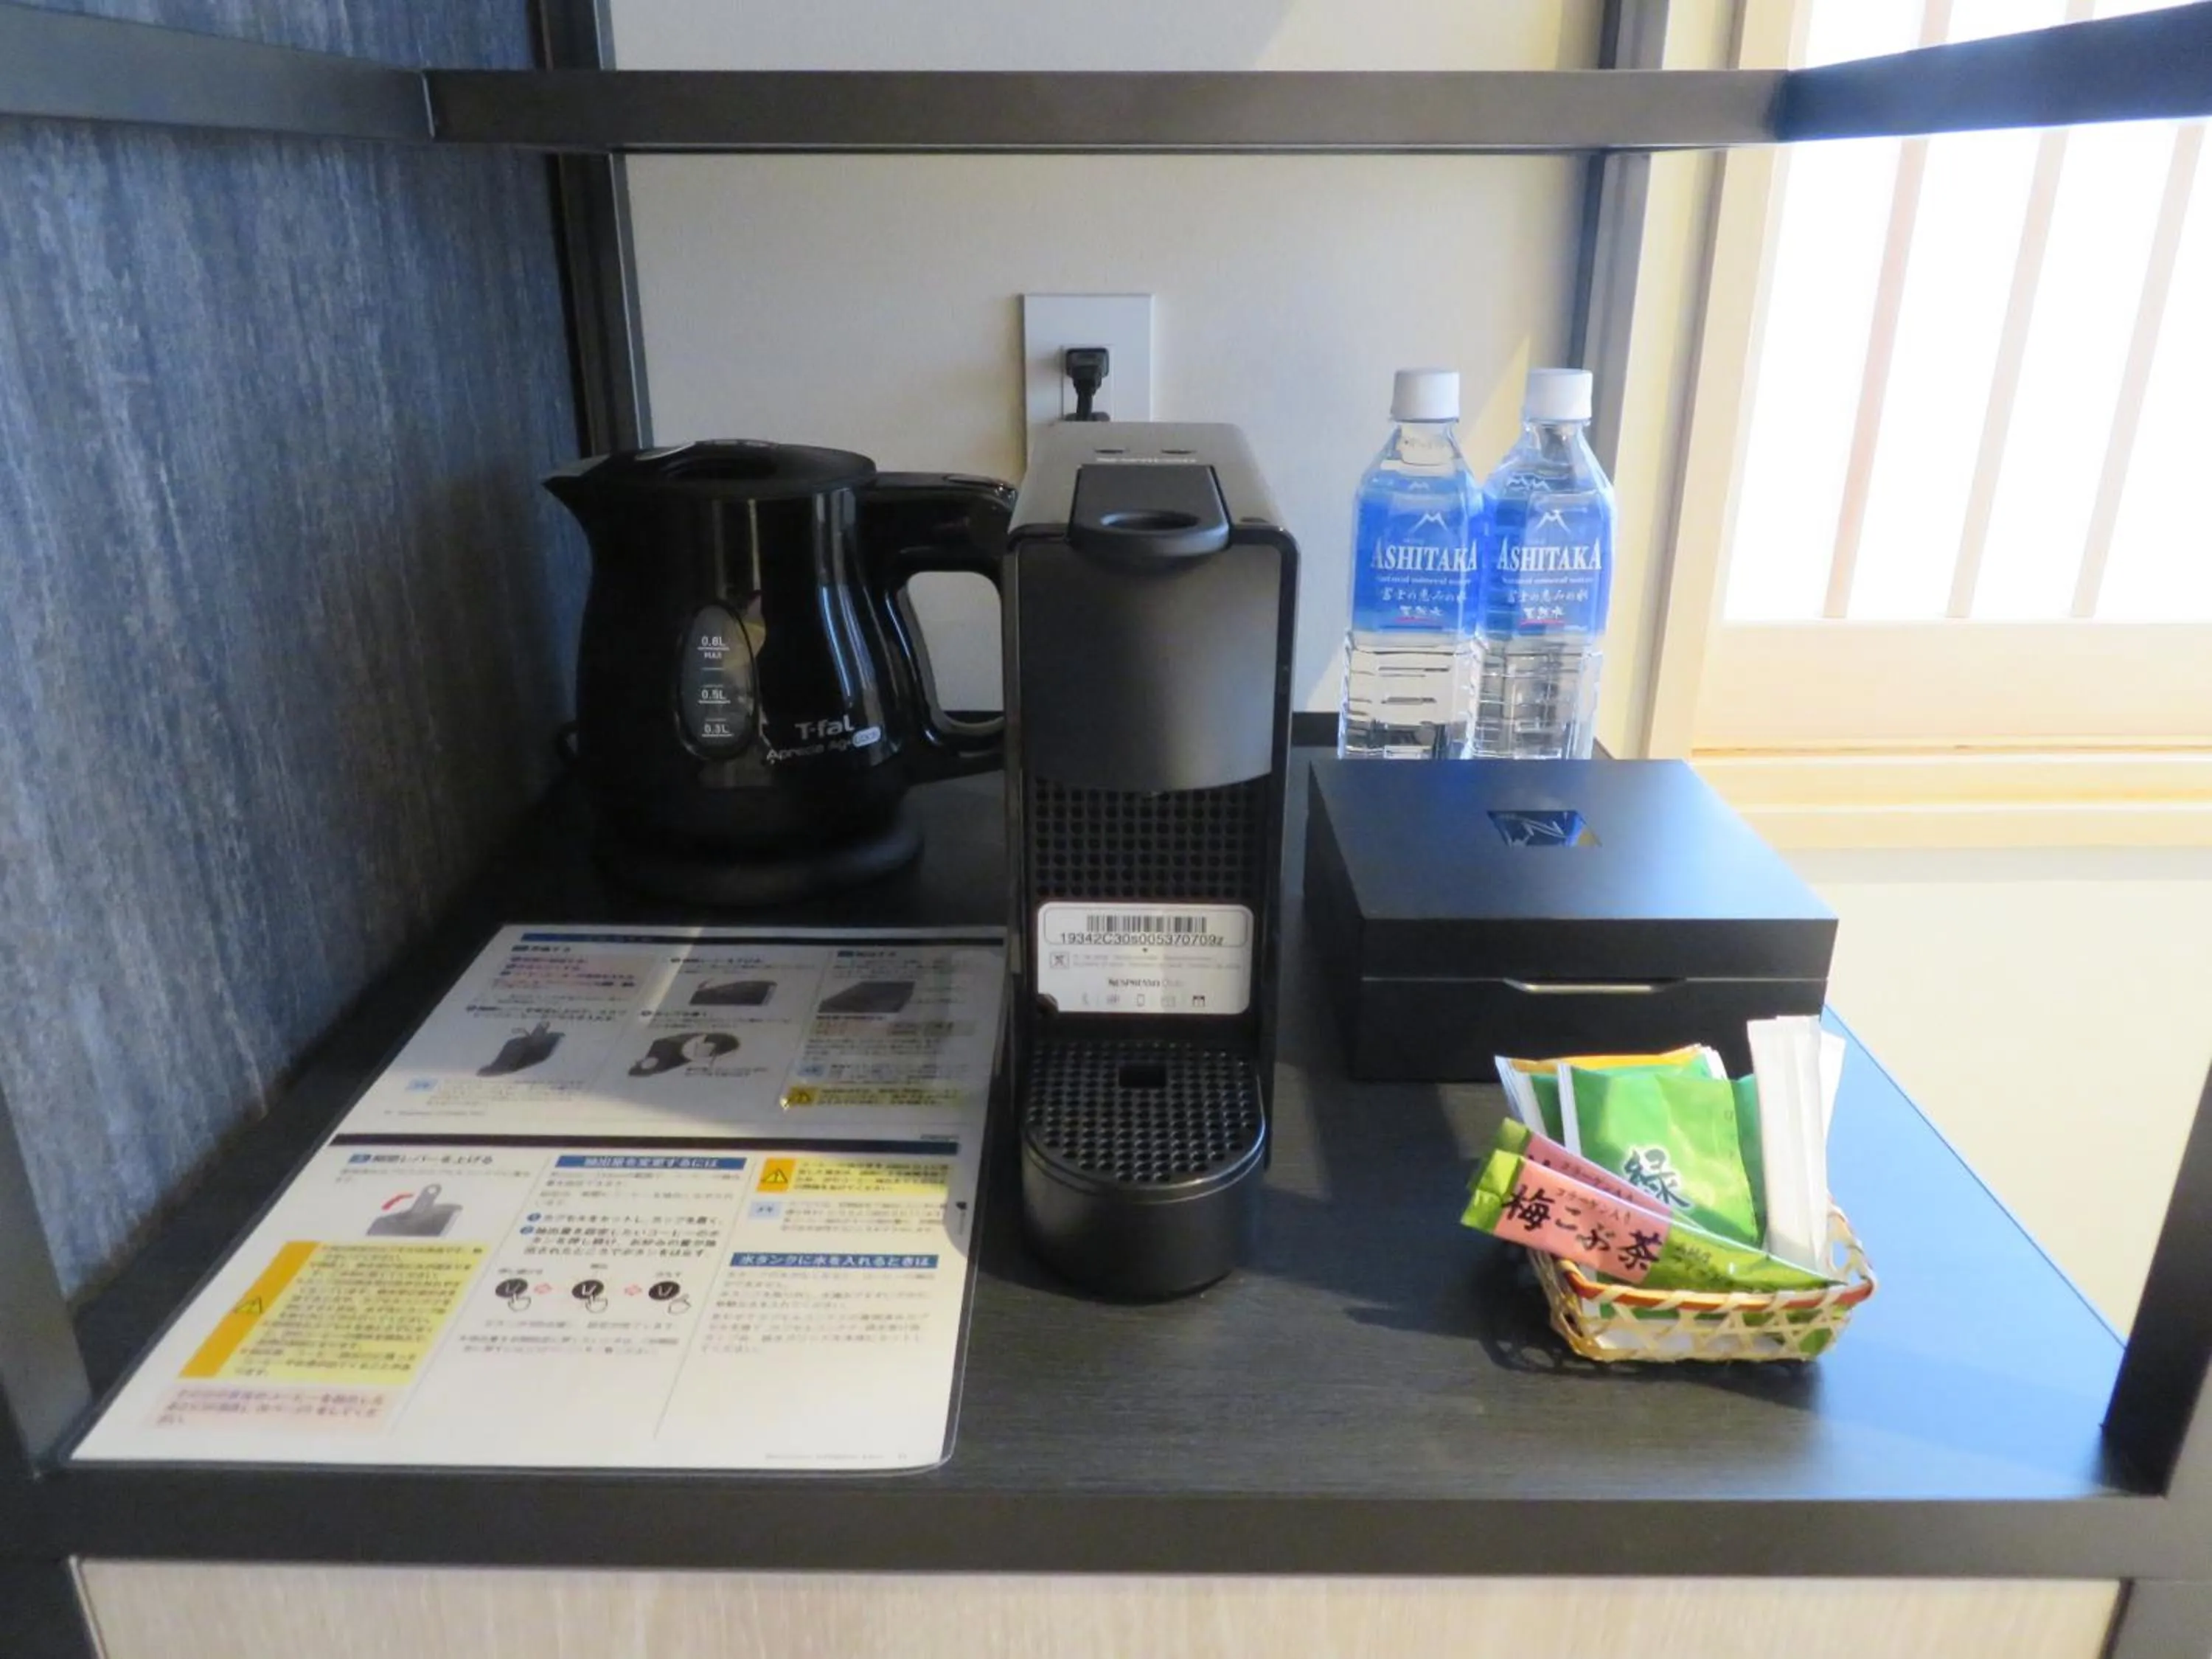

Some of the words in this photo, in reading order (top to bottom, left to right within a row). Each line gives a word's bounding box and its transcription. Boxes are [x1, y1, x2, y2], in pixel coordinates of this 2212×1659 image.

[1371, 538, 1478, 571] ASHITAKA
[1497, 537, 1602, 571] ASHITAKA
[700, 689, 726, 700] 0.5L
[1621, 1146, 1691, 1210] 緑
[1500, 1183, 1665, 1272] 梅こぶ茶
